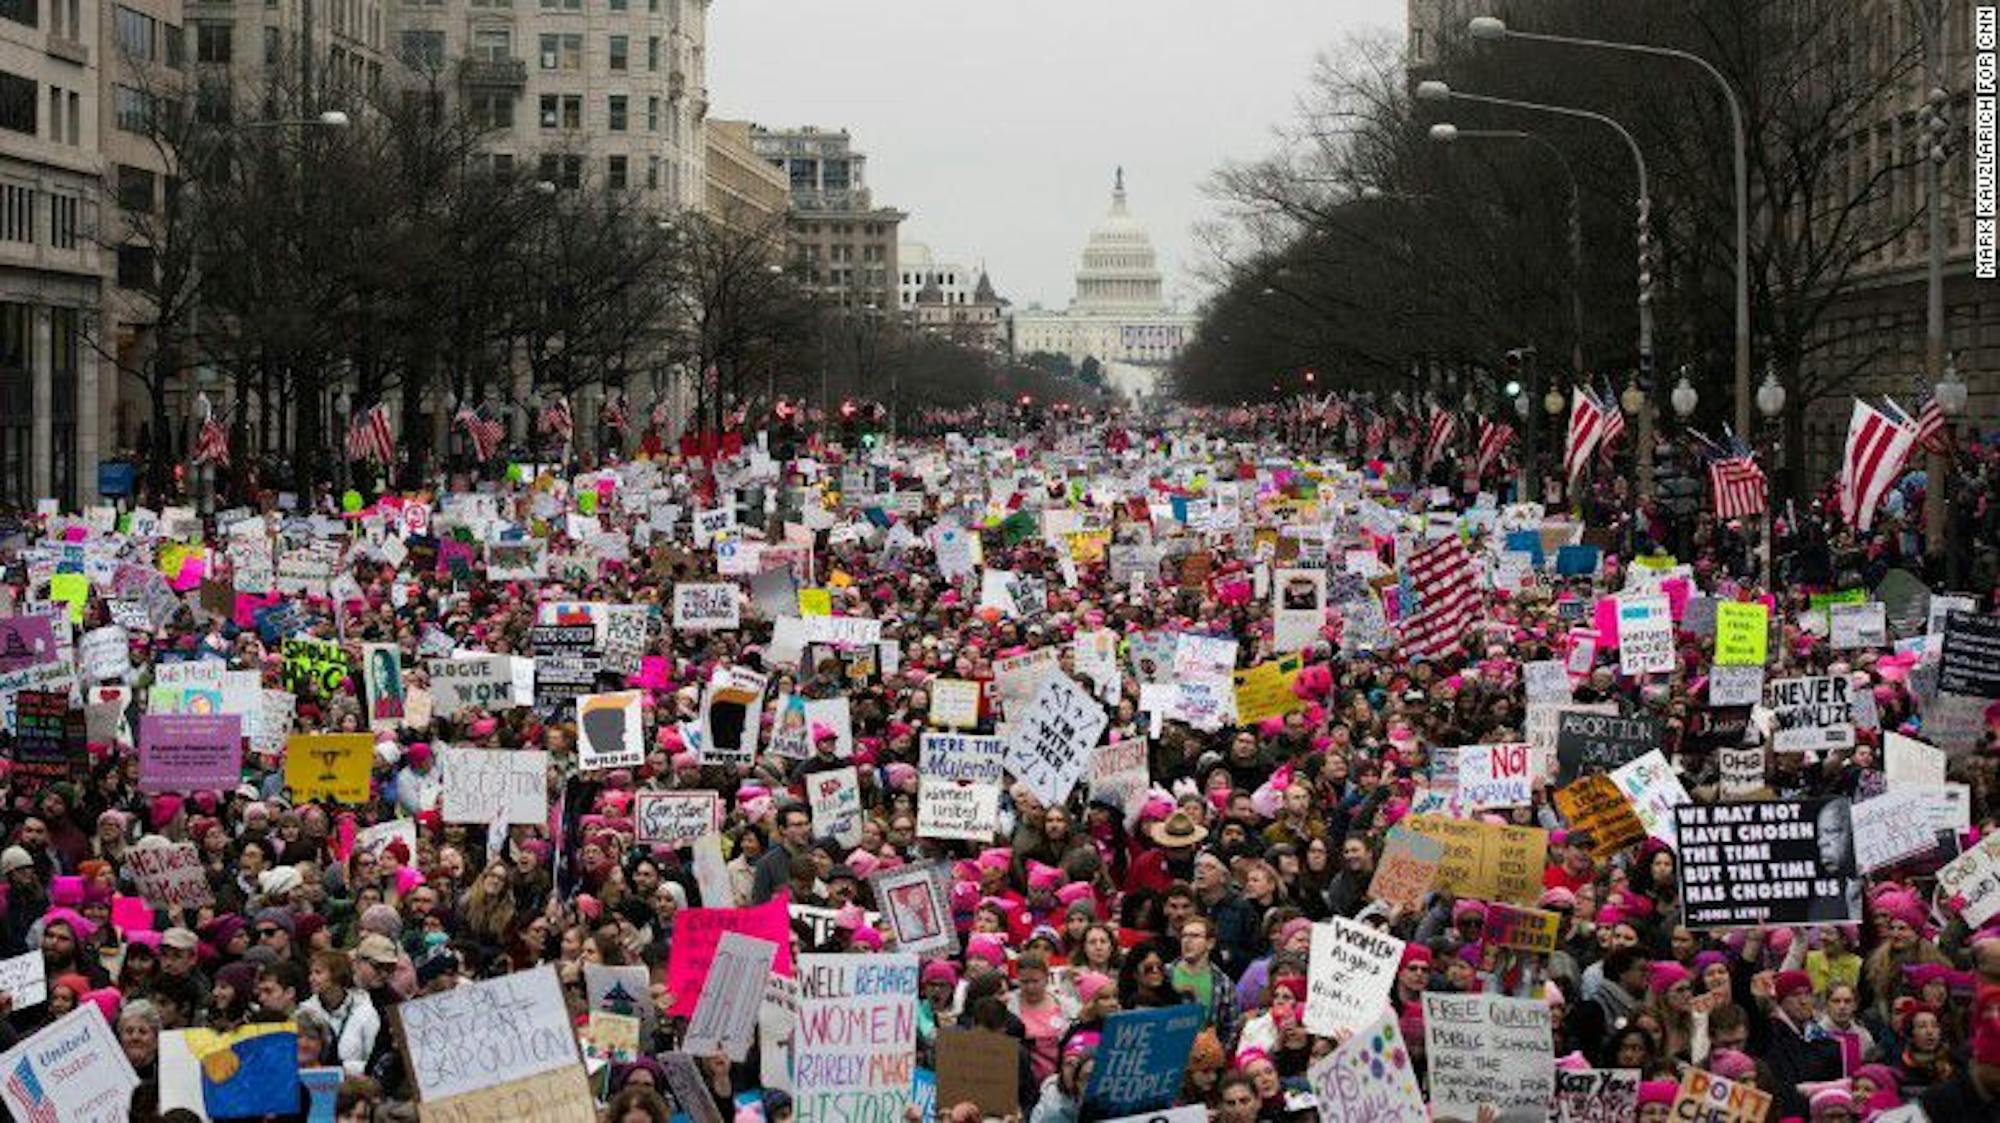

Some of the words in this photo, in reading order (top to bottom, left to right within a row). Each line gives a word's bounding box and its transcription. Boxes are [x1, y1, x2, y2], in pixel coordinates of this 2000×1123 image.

[454, 682, 511, 703] WON
[1775, 676, 1848, 705] NEVER
[1040, 720, 1076, 761] WITH
[1562, 715, 1654, 741] ABORTION
[586, 753, 641, 768] WRONG
[1035, 739, 1065, 774] HER
[1490, 746, 1530, 780] NOT
[1678, 807, 1707, 824] WE
[1713, 805, 1755, 823] MAY
[1760, 803, 1801, 821] NOT
[1681, 825, 1732, 844] HAVE
[1738, 821, 1814, 841] CHOSEN
[1681, 846, 1719, 863] THE
[1723, 843, 1772, 861] TIME
[1684, 865, 1722, 884] BUT
[1727, 863, 1765, 881] THE
[1769, 860, 1816, 878] TIME
[1686, 884, 1727, 903] HAS
[1731, 881, 1809, 900] CHOSEN
[1814, 878, 1840, 897] US
[1334, 920, 1396, 959] WOMEN
[800, 964, 851, 1000] WELL
[1428, 997, 1481, 1020] FREE
[800, 1000, 914, 1047] WOMEN
[1114, 1021, 1156, 1049] WE
[39, 1027, 92, 1068] United
[1106, 1046, 1150, 1076] THE
[50, 1051, 100, 1085] States
[797, 1052, 865, 1089] RARELY
[868, 1052, 913, 1088] MAKE
[1435, 1055, 1463, 1070] ARE
[1472, 1055, 1502, 1072] THE
[1097, 1068, 1179, 1104] PEOPLE
[796, 1089, 910, 1123] HISTORY
